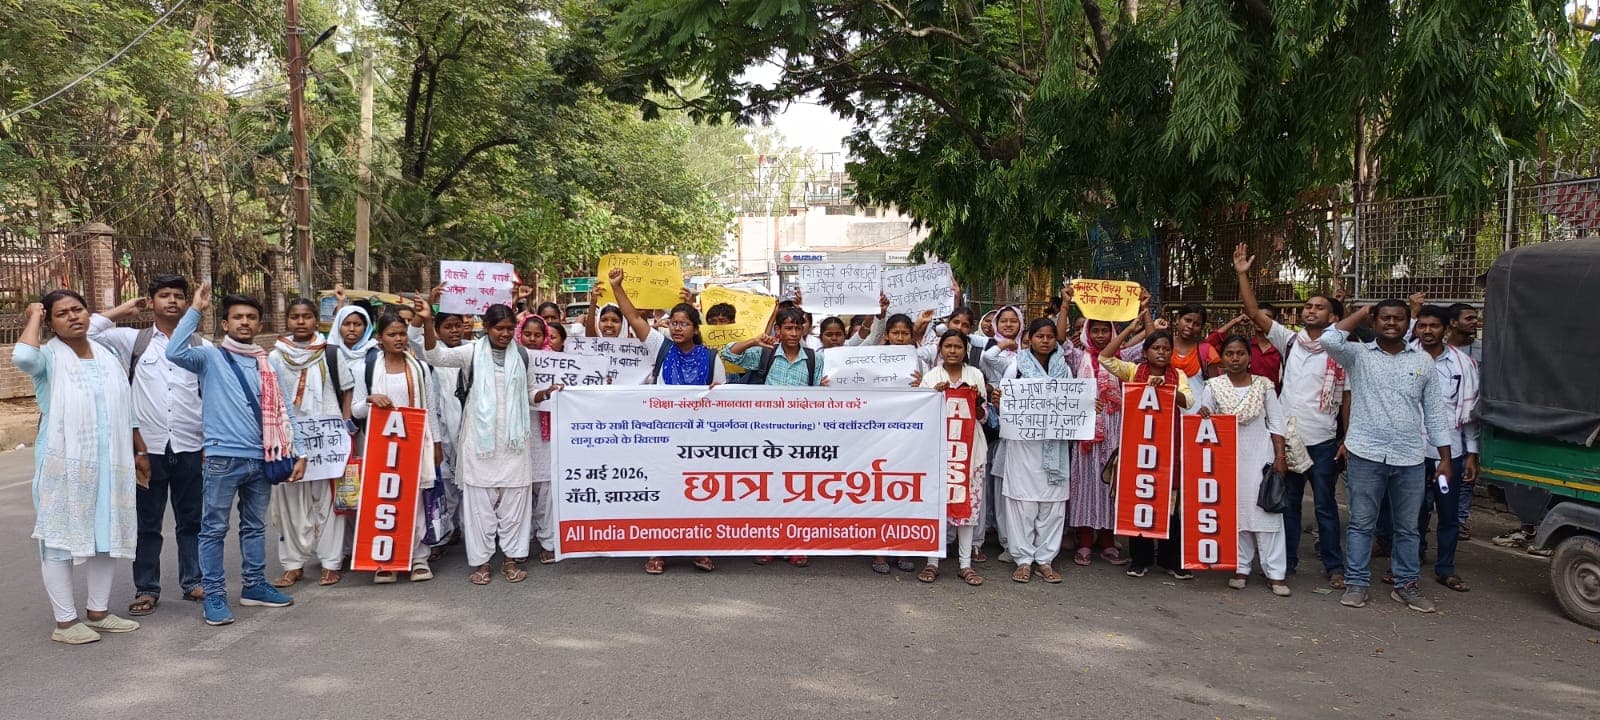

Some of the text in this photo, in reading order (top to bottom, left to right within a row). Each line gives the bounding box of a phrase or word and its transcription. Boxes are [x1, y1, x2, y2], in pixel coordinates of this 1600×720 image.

[847, 280, 878, 293] करनी
[1126, 285, 1139, 296] पर
[1080, 292, 1098, 304] रोक
[582, 370, 604, 386] करो
[1045, 379, 1058, 394] की
[754, 397, 785, 409] बचाओ
[787, 397, 825, 409] आंदोलन
[828, 397, 843, 409] तेज
[1002, 396, 1017, 410] को
[319, 418, 345, 431] नाम
[570, 420, 593, 431] राज्य
[596, 420, 607, 430] के
[609, 419, 629, 430] सभी
[631, 418, 694, 430] विश्वविद्यालयों
[696, 418, 704, 429] में
[750, 420, 816, 431] (Restructuring)
[823, 420, 836, 431] एवं
[887, 421, 924, 430] व्यवस्था
[1062, 411, 1088, 426] जारी
[327, 431, 342, 446] को
[1019, 425, 1078, 440] रखना होगा
[570, 434, 670, 448] लागू करने के खिलाफ
[676, 440, 840, 462] राज्यपाल के समक्ष
[946, 398, 972, 504] AIDSO
[1133, 385, 1160, 528] AIDSO
[565, 464, 648, 481] 25 मई 2026,
[371, 411, 407, 561] AIDSO
[682, 459, 927, 504] छात्र प्रदर्शन
[565, 488, 661, 505] राँची, झारखंड
[1195, 418, 1219, 564] AIDSO
[565, 523, 936, 544] All India Democratic Students' Organisation (AIDSO)
